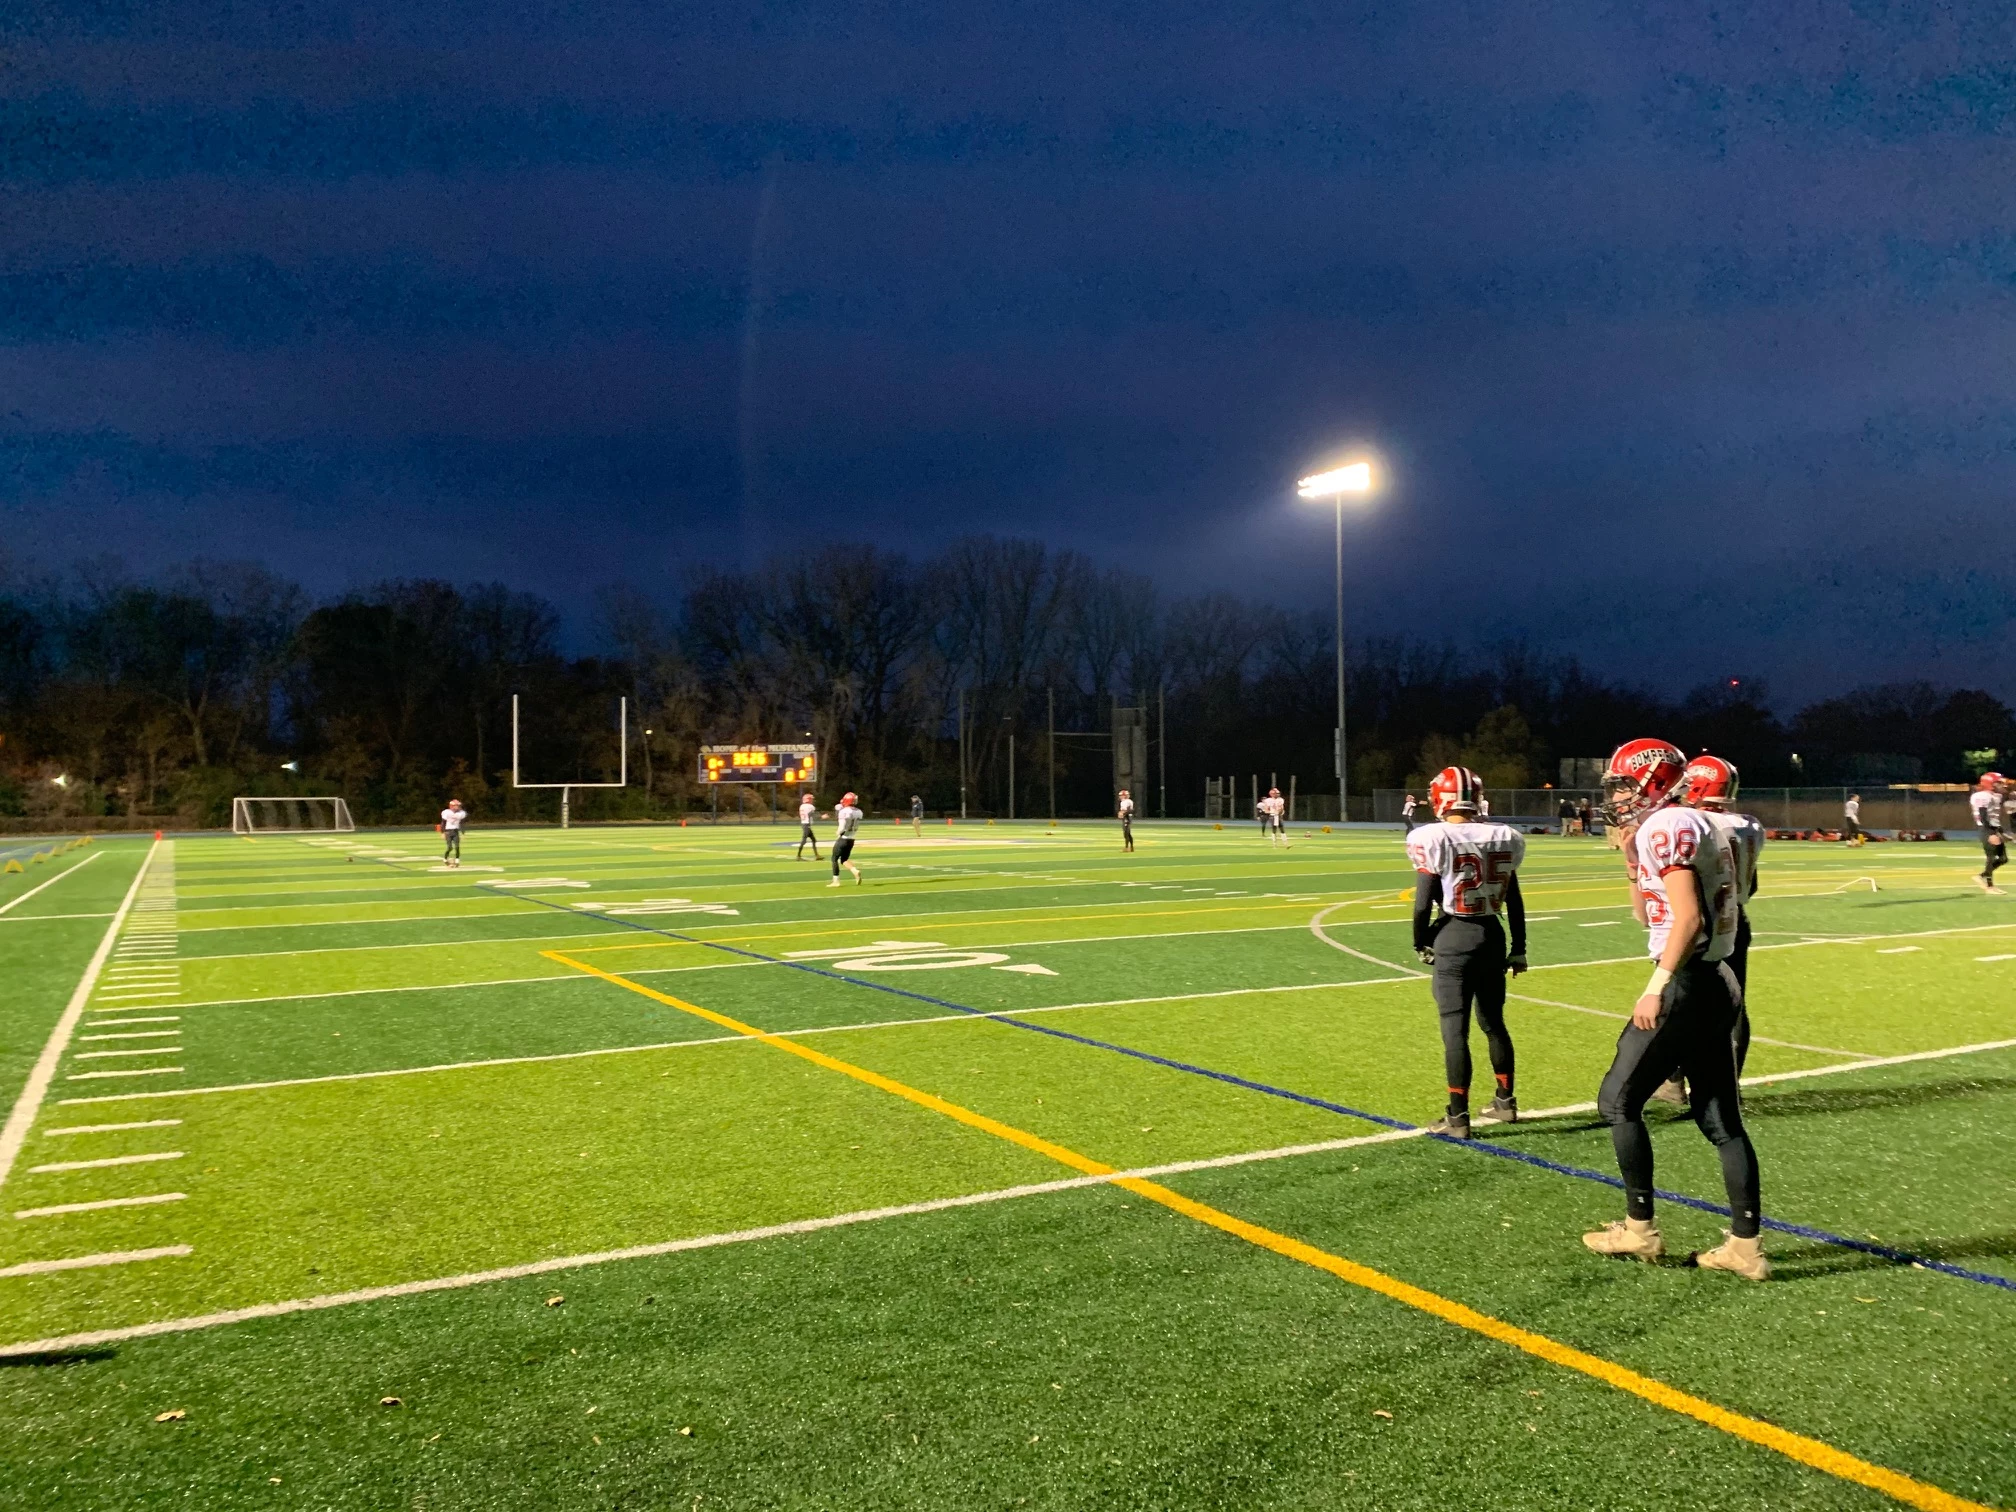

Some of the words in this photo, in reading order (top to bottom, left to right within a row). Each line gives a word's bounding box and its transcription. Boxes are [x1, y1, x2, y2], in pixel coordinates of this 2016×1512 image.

[1650, 828, 1698, 861] 26
[1453, 851, 1513, 915] 25
[779, 941, 1011, 971] 10
